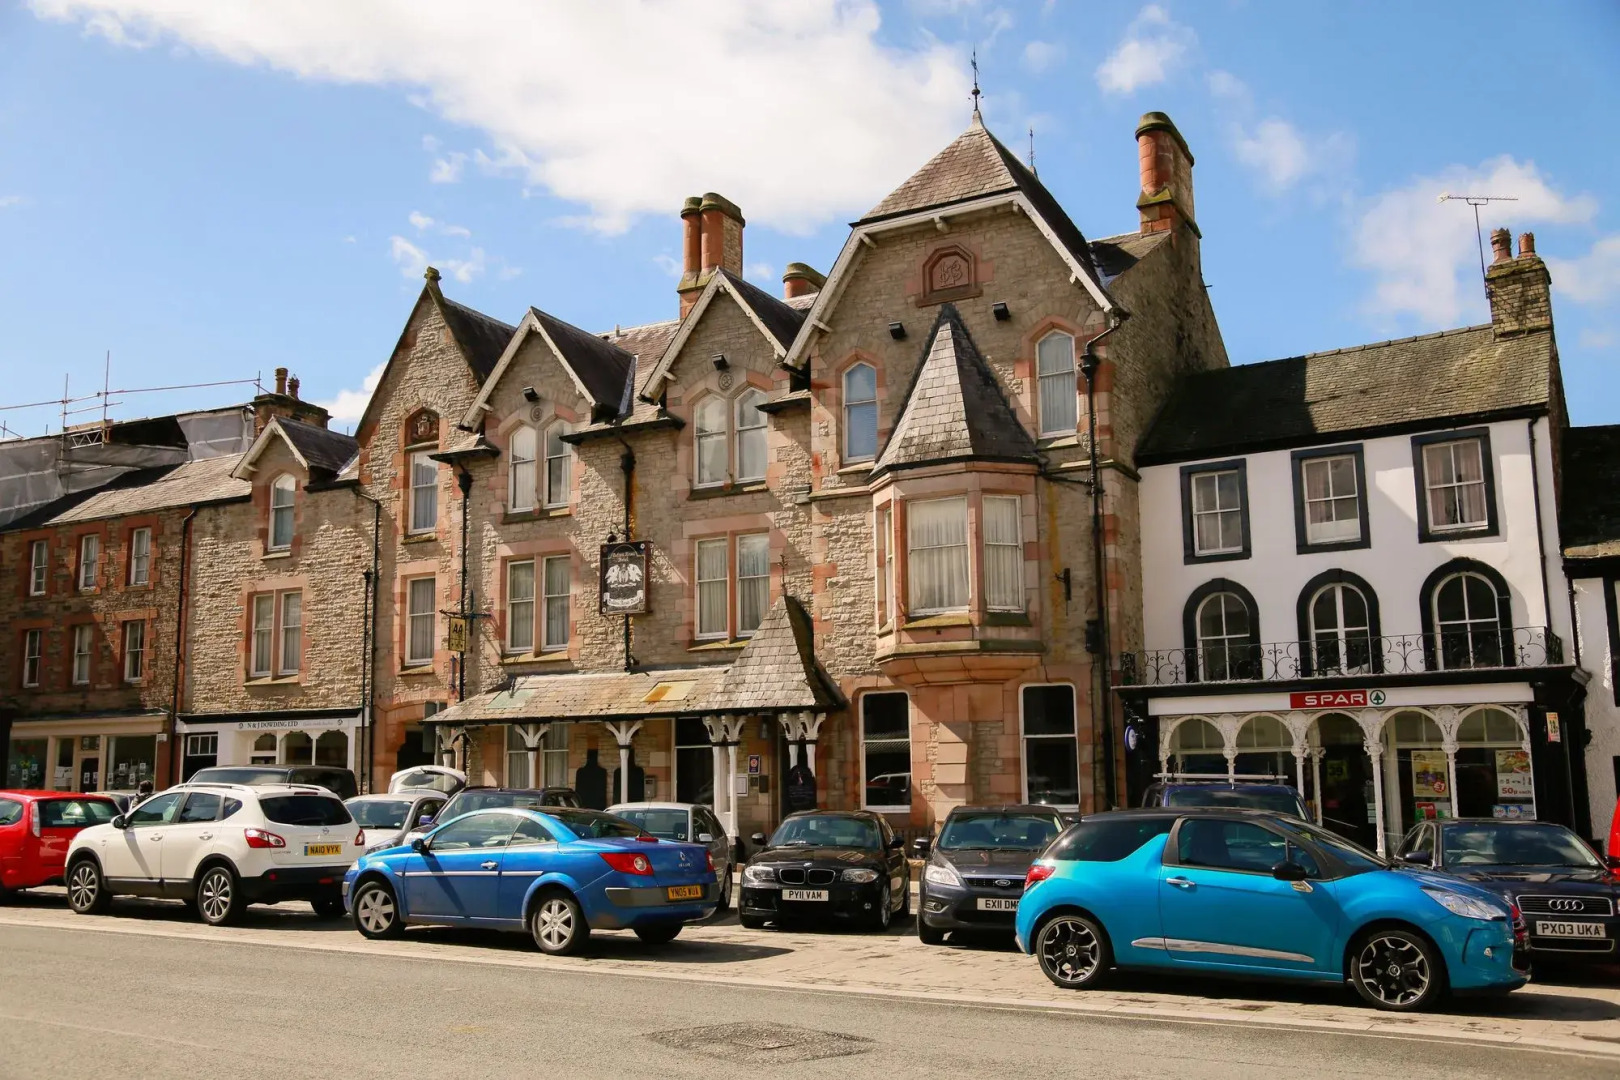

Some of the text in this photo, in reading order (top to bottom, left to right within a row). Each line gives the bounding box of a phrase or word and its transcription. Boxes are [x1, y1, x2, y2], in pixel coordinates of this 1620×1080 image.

[1304, 693, 1364, 706] SPAR
[1502, 787, 1518, 795] 50p
[326, 845, 339, 853] VYX
[671, 887, 687, 897] YN05
[788, 890, 822, 899] PY11 VAM
[985, 899, 1020, 909] EX11 DM
[1541, 923, 1601, 936] PX03 UKA
